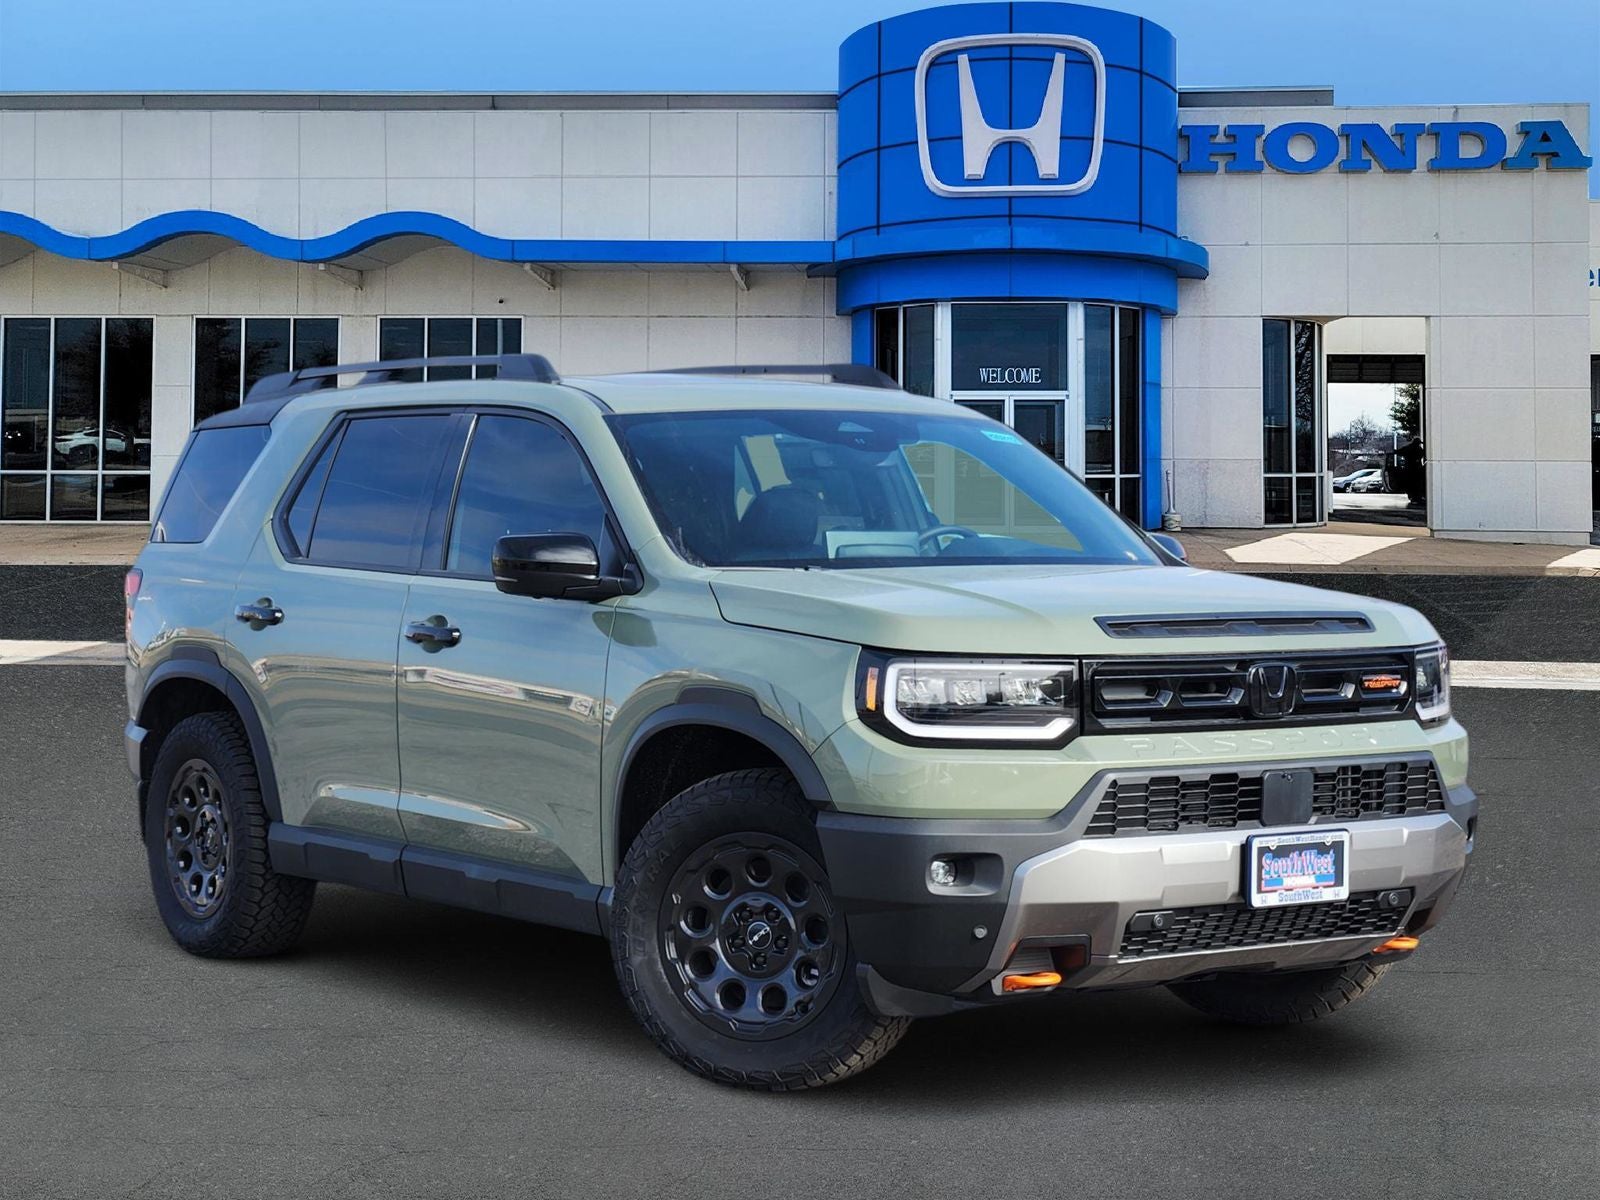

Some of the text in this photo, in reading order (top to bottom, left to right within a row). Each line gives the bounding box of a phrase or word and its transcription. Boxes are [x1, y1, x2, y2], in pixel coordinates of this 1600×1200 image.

[1178, 119, 1593, 174] HONDA
[979, 367, 1041, 384] WELCOME
[1124, 724, 1397, 757] PASSPORT
[1262, 848, 1335, 878] SouthWest
